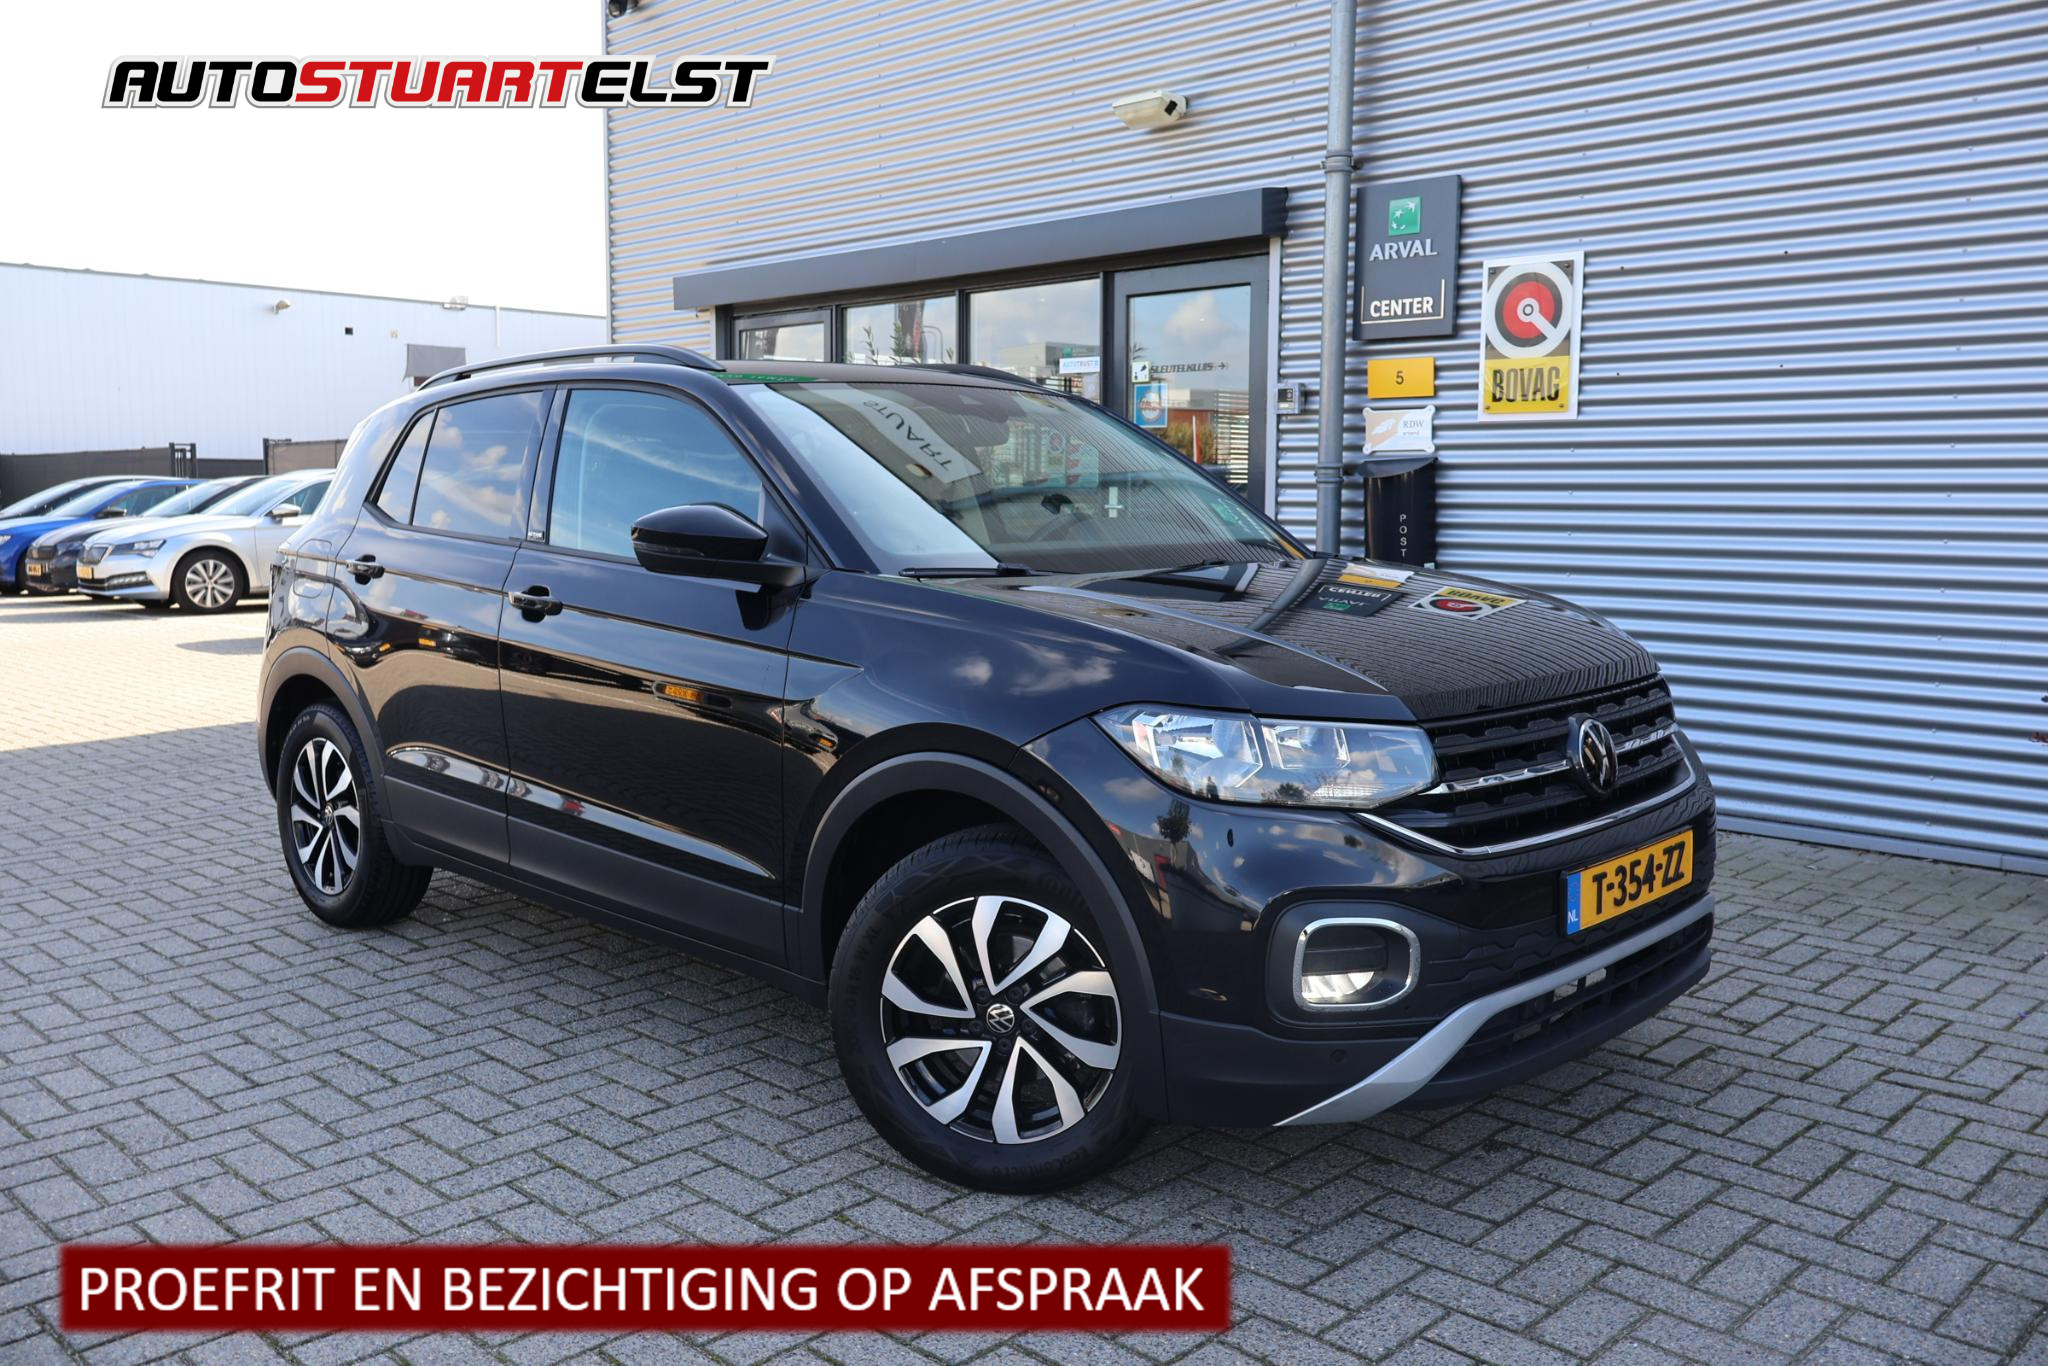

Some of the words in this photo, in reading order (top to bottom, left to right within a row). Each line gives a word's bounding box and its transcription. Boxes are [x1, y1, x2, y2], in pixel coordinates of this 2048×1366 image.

[1369, 238, 1438, 262] ARVAL
[1370, 296, 1434, 318] CENTER
[1395, 370, 1405, 385] 5
[1492, 366, 1560, 403] BOVAG
[1402, 419, 1424, 429] RDW
[1592, 840, 1685, 916] T-354-ZZ
[1567, 908, 1579, 924] NL
